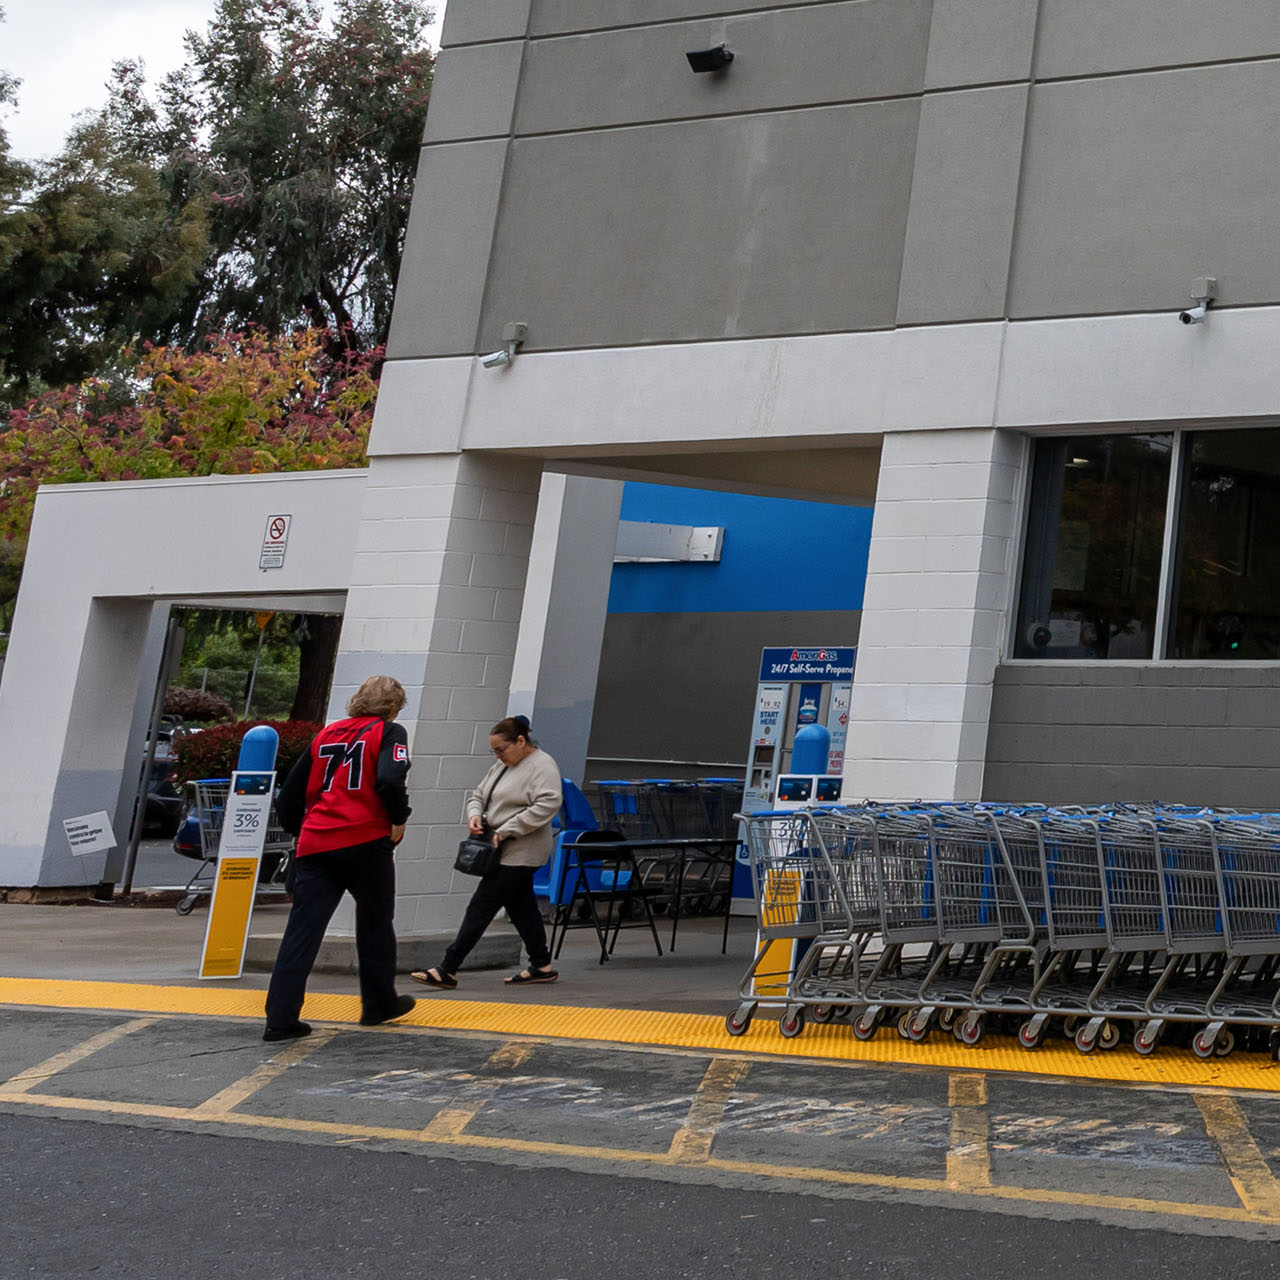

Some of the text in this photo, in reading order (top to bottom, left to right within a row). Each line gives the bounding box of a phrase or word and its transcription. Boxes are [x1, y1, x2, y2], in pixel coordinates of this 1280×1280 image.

[790, 649, 838, 662] AmeriGas
[770, 663, 853, 677] 24/7 Self-Serve Propane
[760, 711, 779, 719] START
[318, 740, 366, 793] 71
[233, 813, 260, 828] 3%
